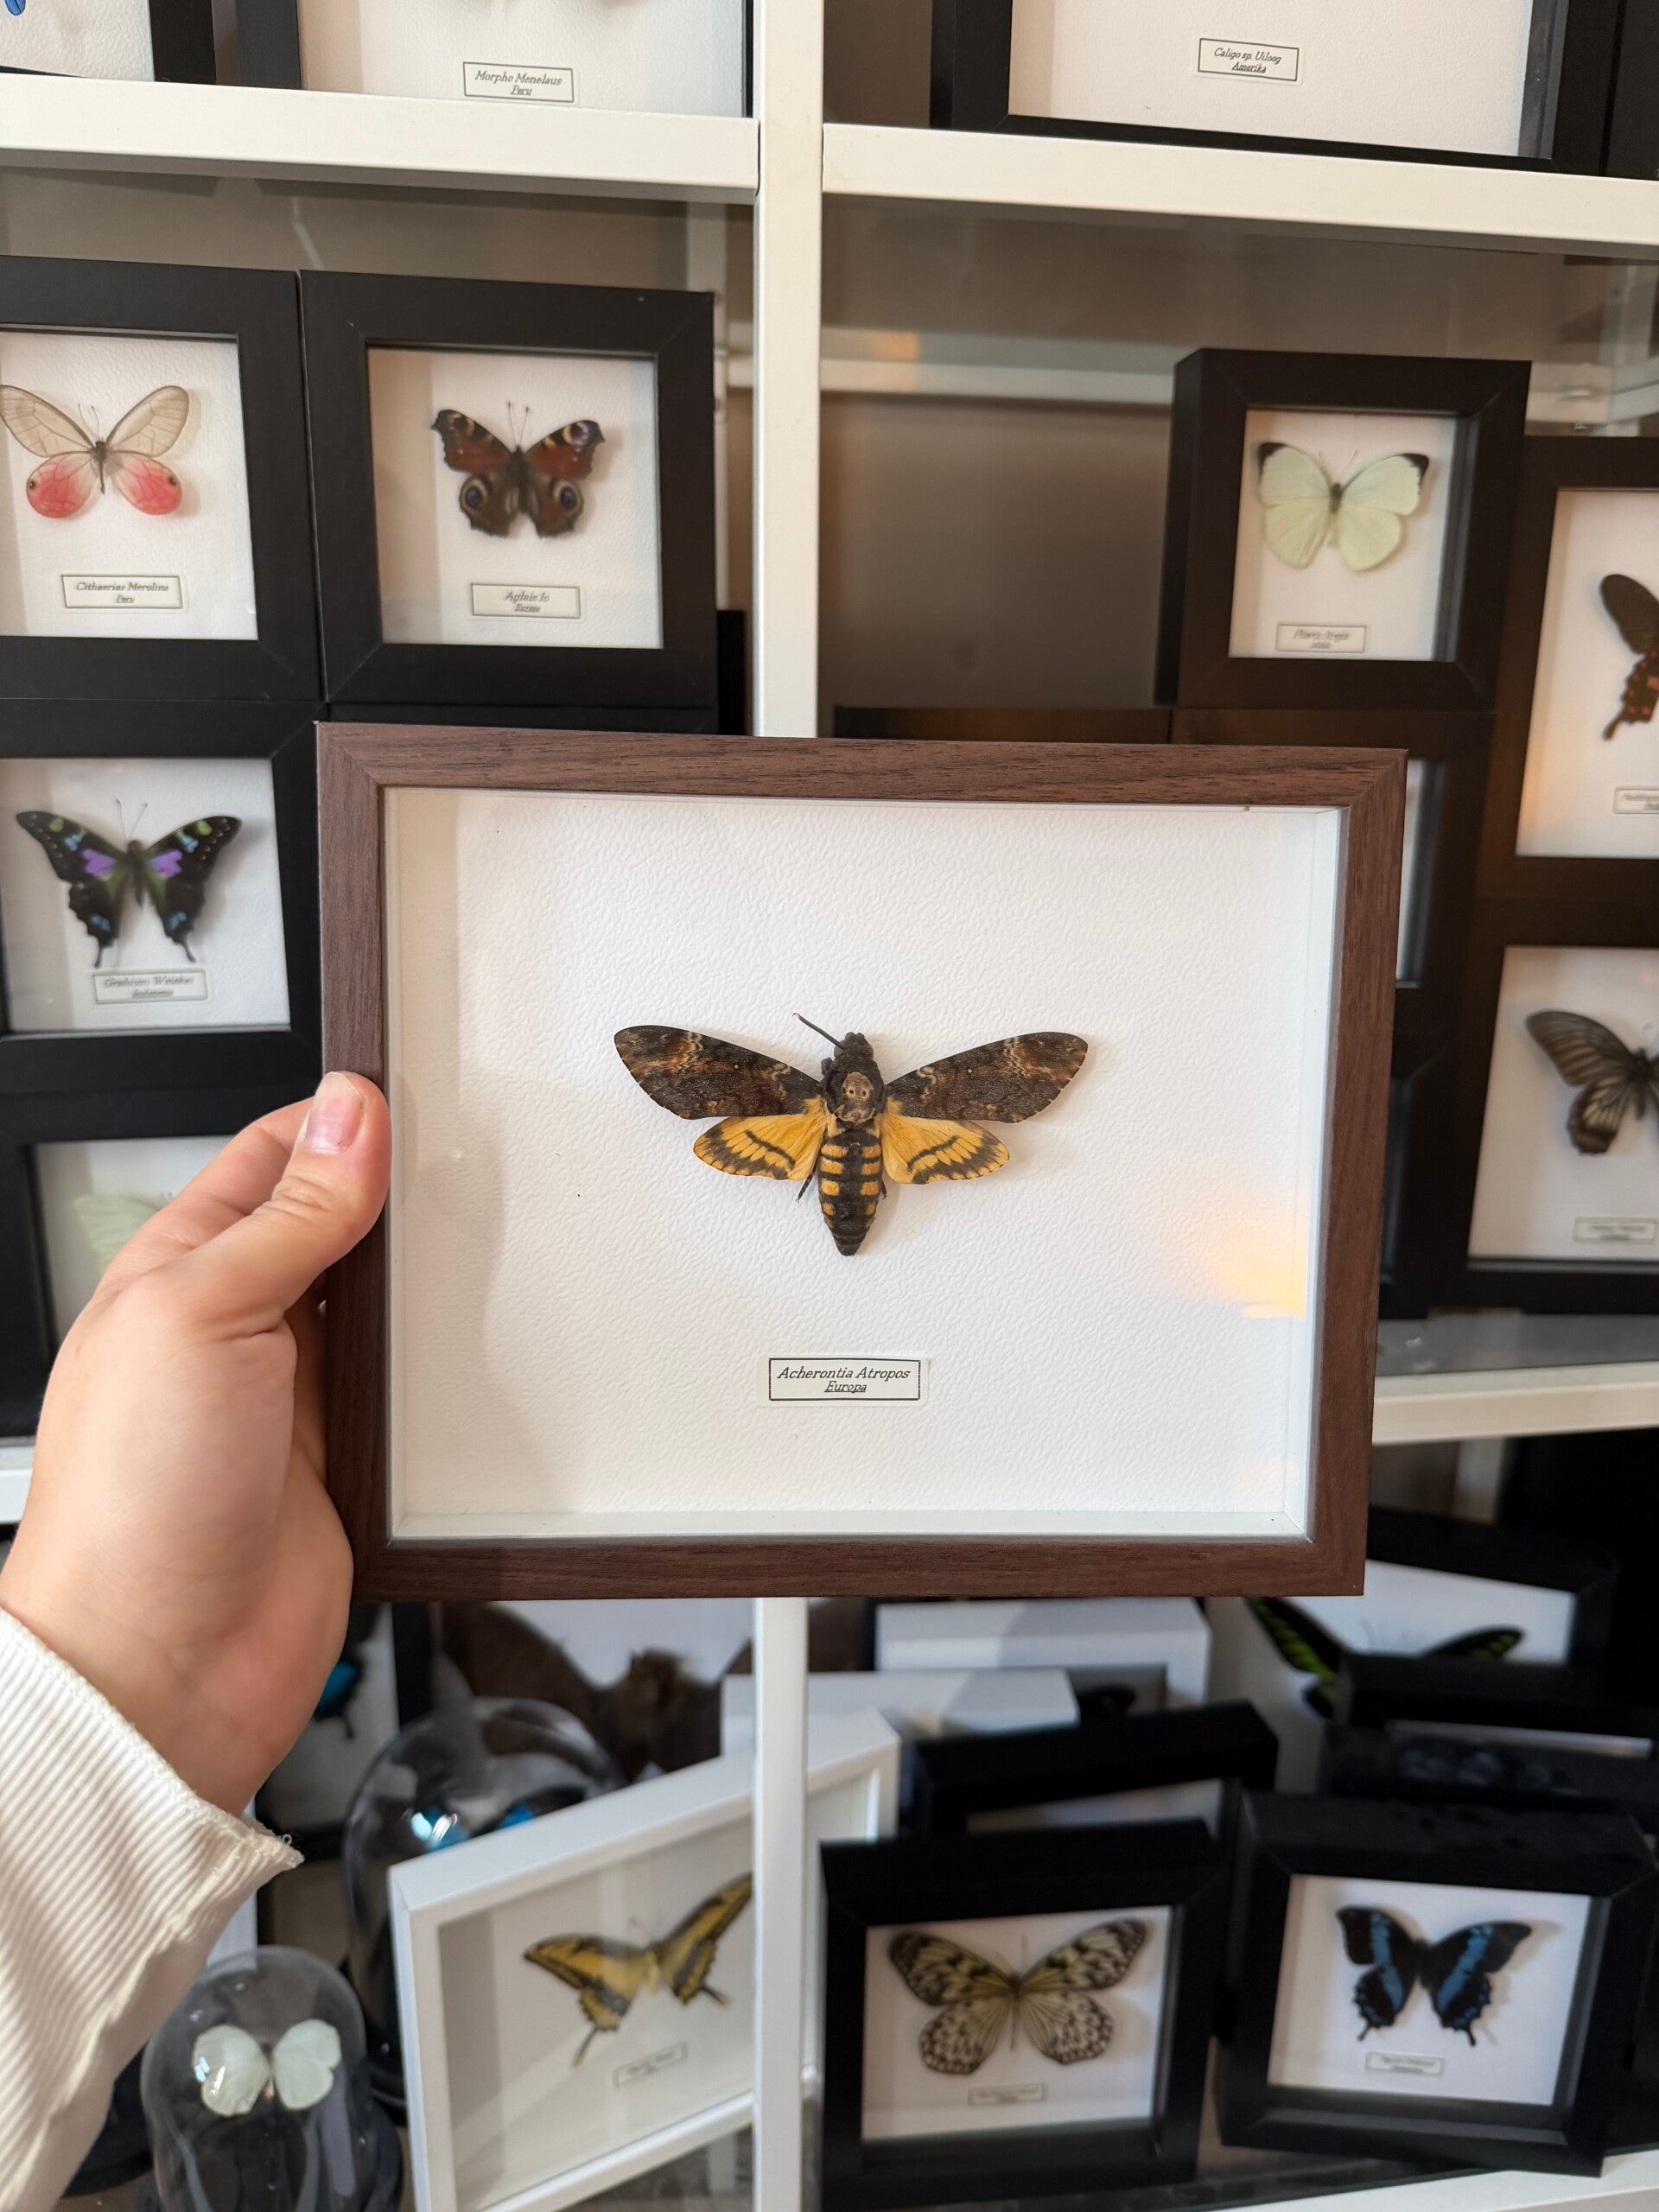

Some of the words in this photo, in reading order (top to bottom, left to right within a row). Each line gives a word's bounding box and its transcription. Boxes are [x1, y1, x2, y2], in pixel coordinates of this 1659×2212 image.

[1214, 48, 1241, 60] Caligo
[1255, 51, 1282, 65] Uiloog
[1231, 62, 1267, 73] Amerika
[474, 70, 514, 84] Morpho
[514, 73, 563, 86] Menelaus
[511, 85, 533, 96] Peru
[777, 1366, 854, 1379] Acherontia
[855, 1366, 912, 1382] Atropos
[824, 1380, 868, 1393] Europa
